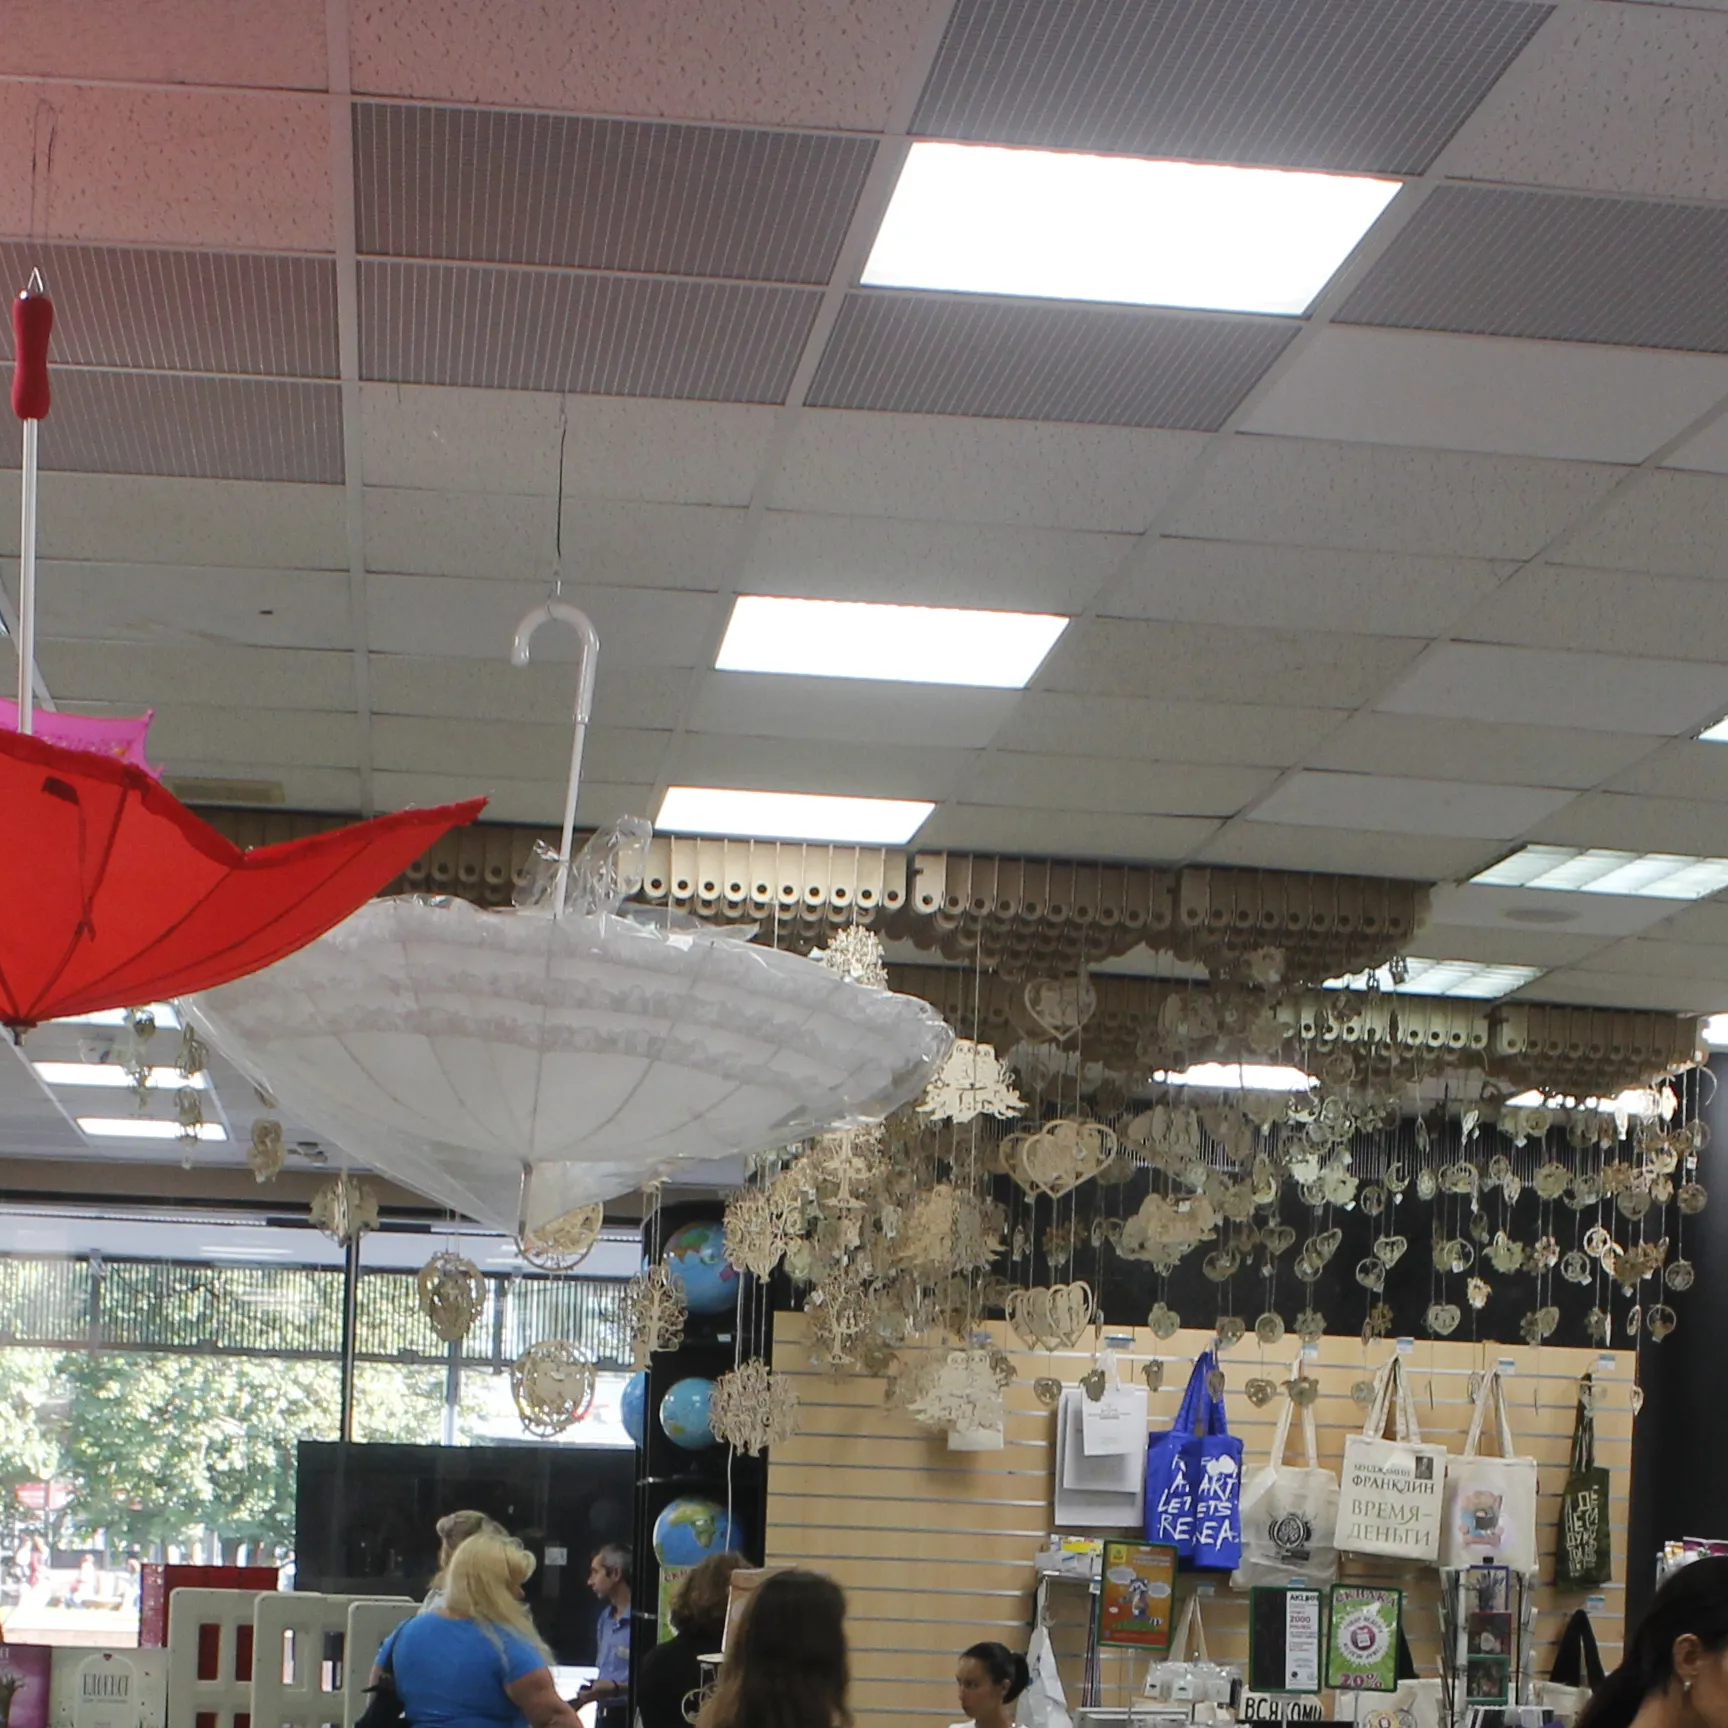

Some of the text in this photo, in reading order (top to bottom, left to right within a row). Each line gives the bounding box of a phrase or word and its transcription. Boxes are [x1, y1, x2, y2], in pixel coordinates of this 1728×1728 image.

[1352, 1475, 1435, 1494] ФРАНКЛИН
[1346, 1523, 1430, 1546] ДЕНЬГИ
[1340, 1673, 1383, 1688] 20%
